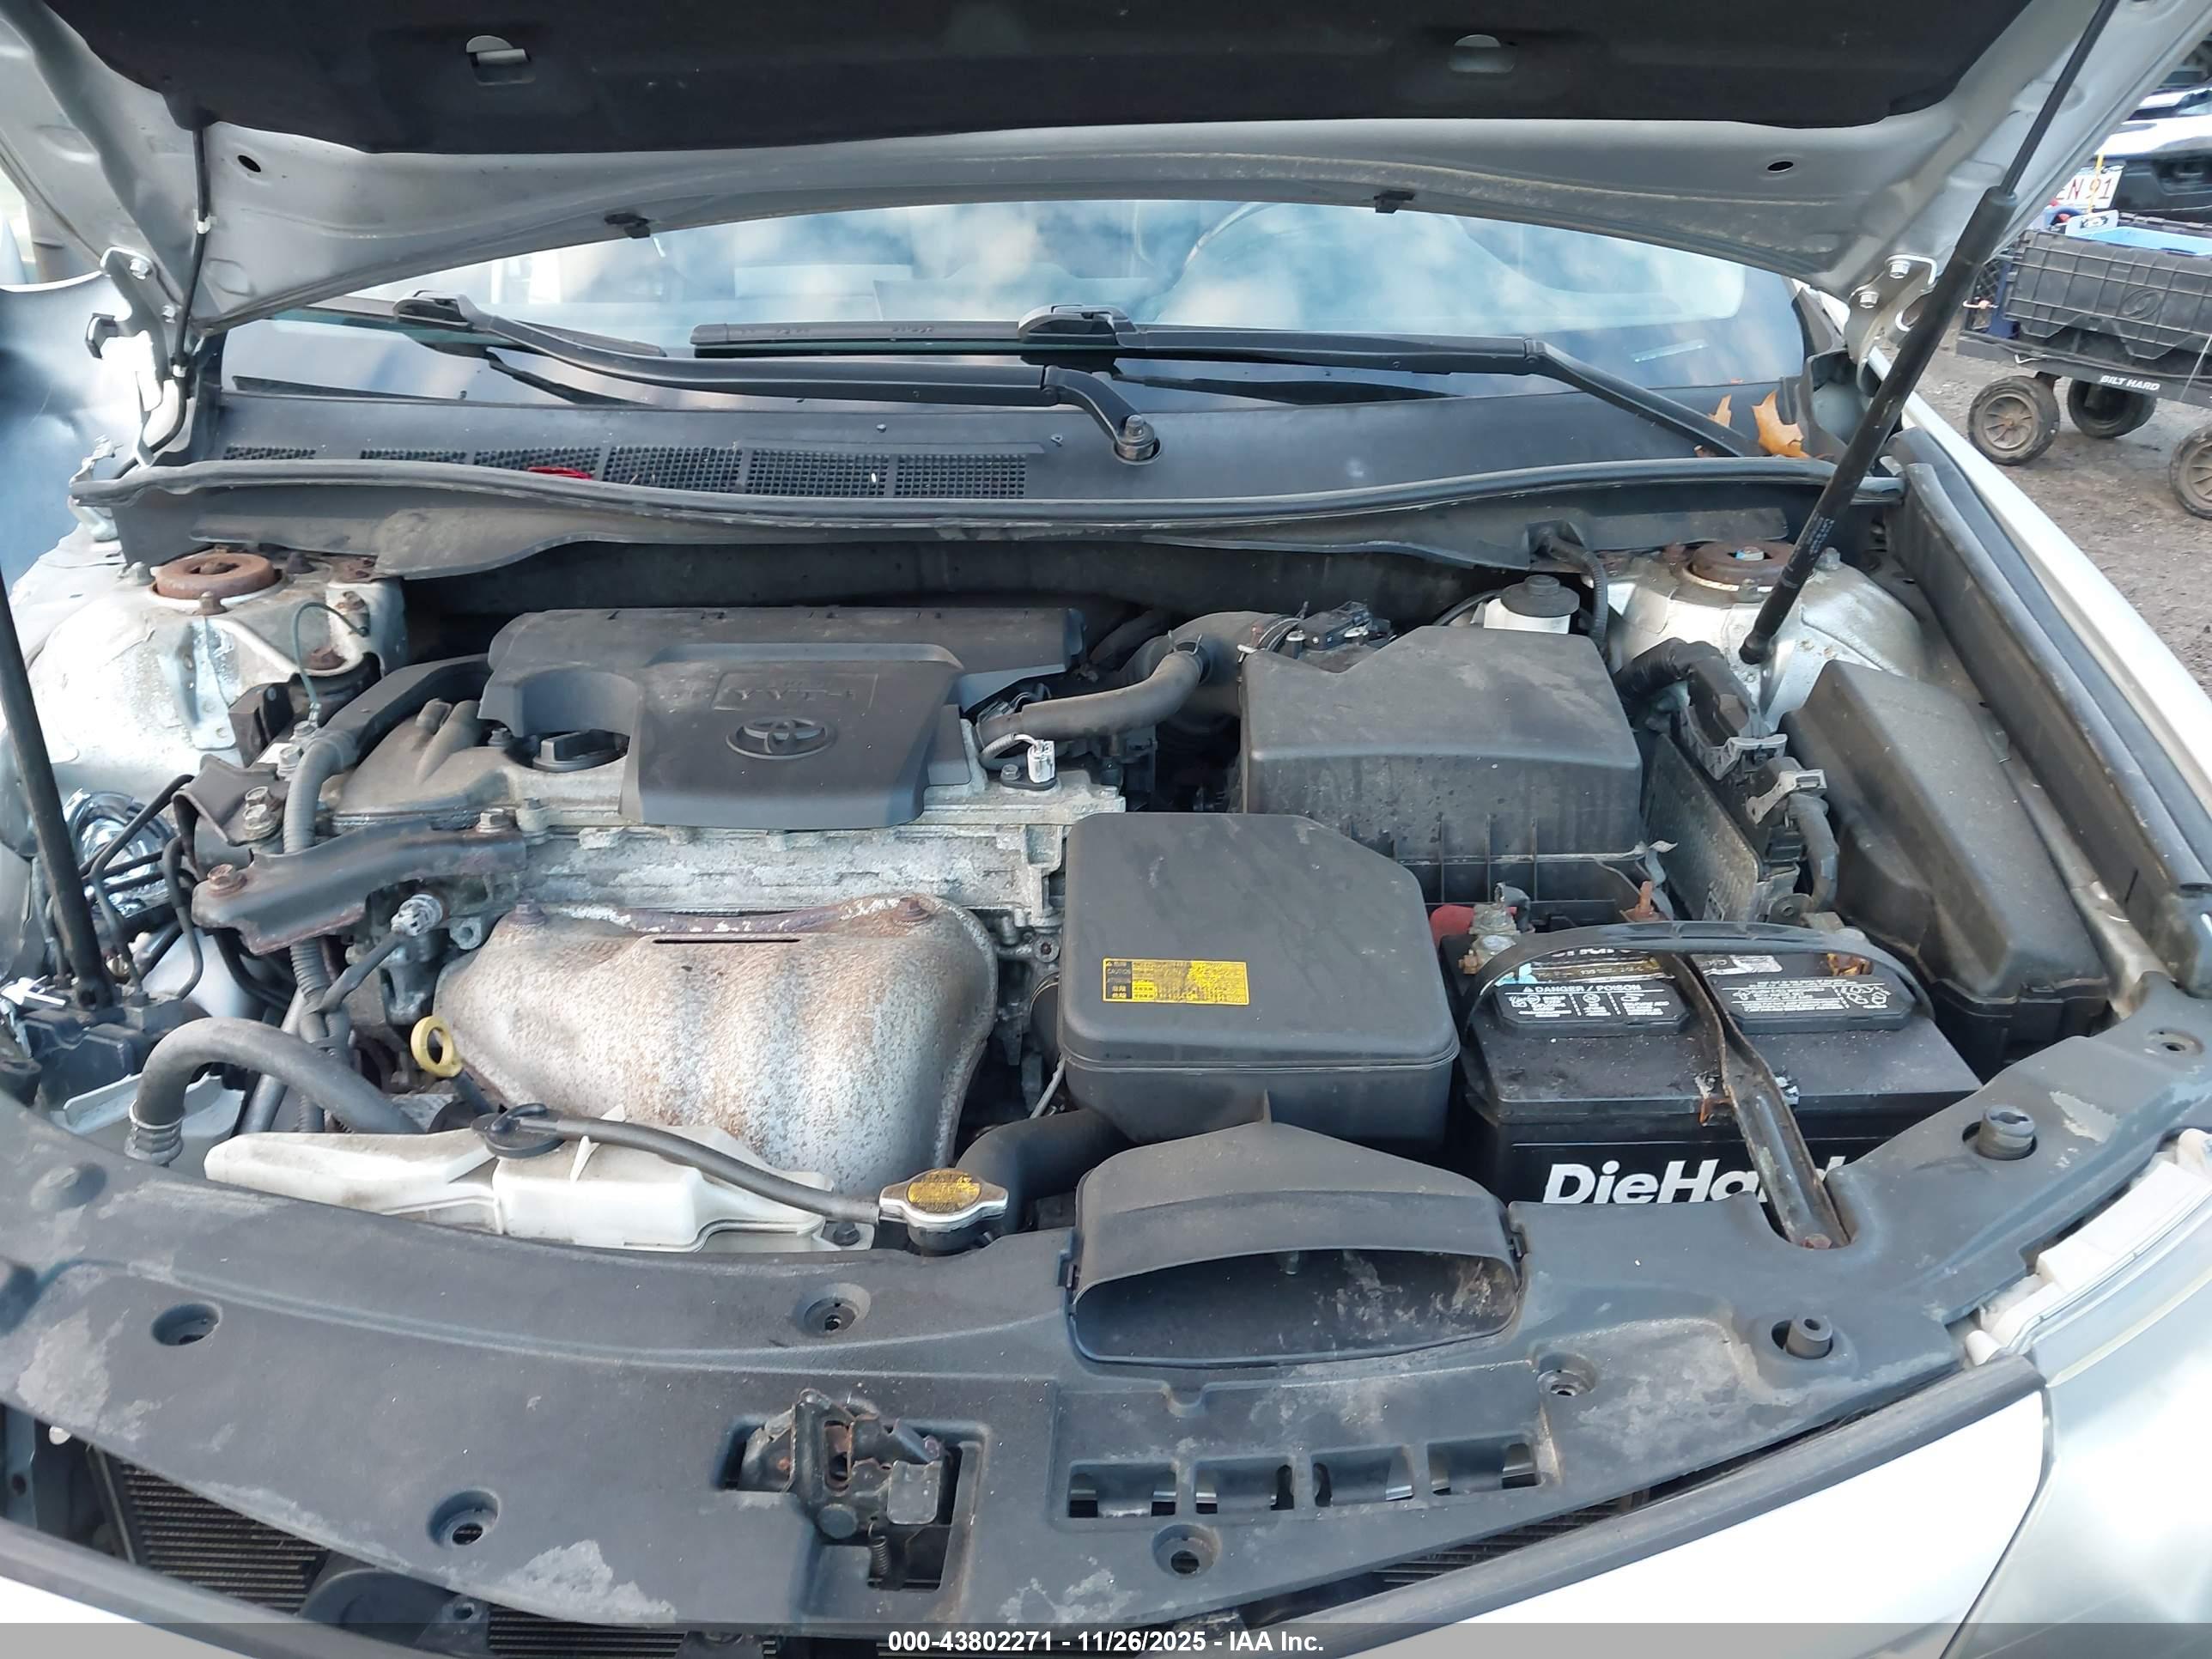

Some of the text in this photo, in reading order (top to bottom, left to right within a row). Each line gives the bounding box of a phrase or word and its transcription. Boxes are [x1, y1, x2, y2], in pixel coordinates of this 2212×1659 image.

[2085, 178, 2112, 200] 91
[2100, 375, 2160, 391] BILT HARD
[1534, 985, 1585, 994] DANGER
[1595, 983, 1643, 992] POISON
[1542, 1155, 1846, 1204] DieHa
